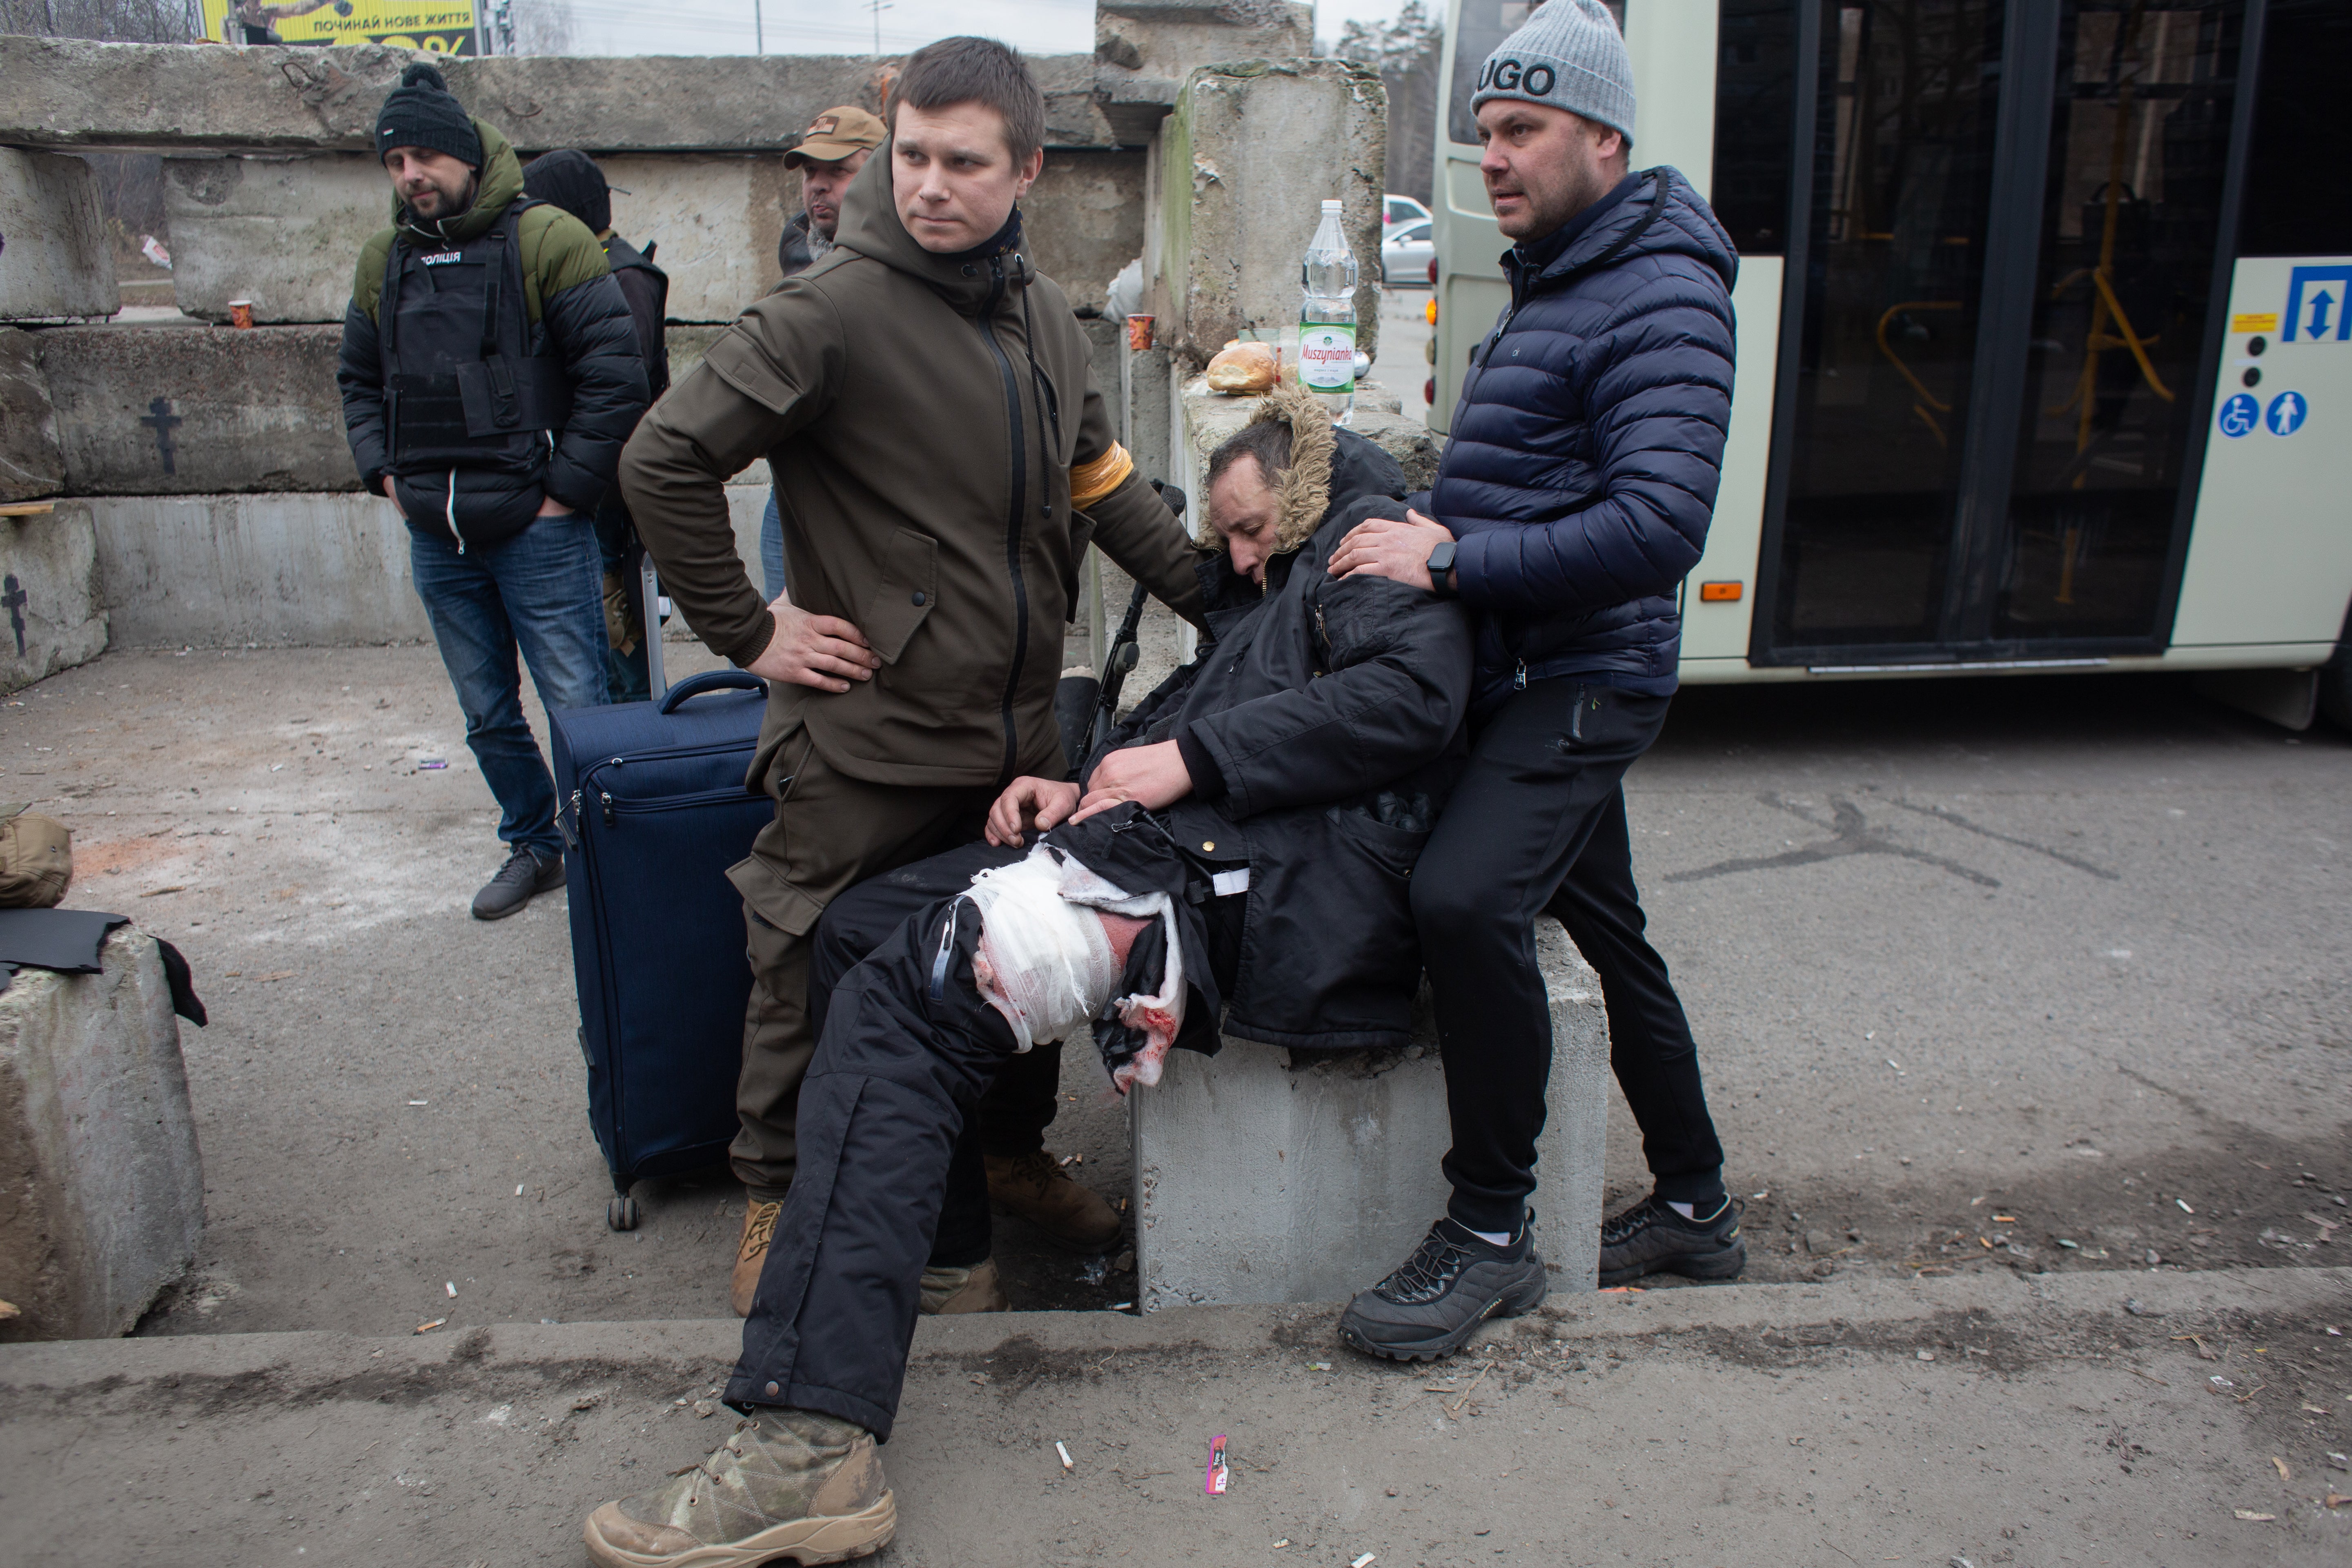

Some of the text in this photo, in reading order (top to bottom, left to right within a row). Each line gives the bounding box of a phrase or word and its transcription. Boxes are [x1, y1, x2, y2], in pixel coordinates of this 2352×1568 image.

[314, 12, 470, 33] ПОЧИНАЙ НОВЕ ЖИТТЯ
[1301, 344, 1352, 365] Muszynianka
[1217, 1477, 1225, 1486] 1+
